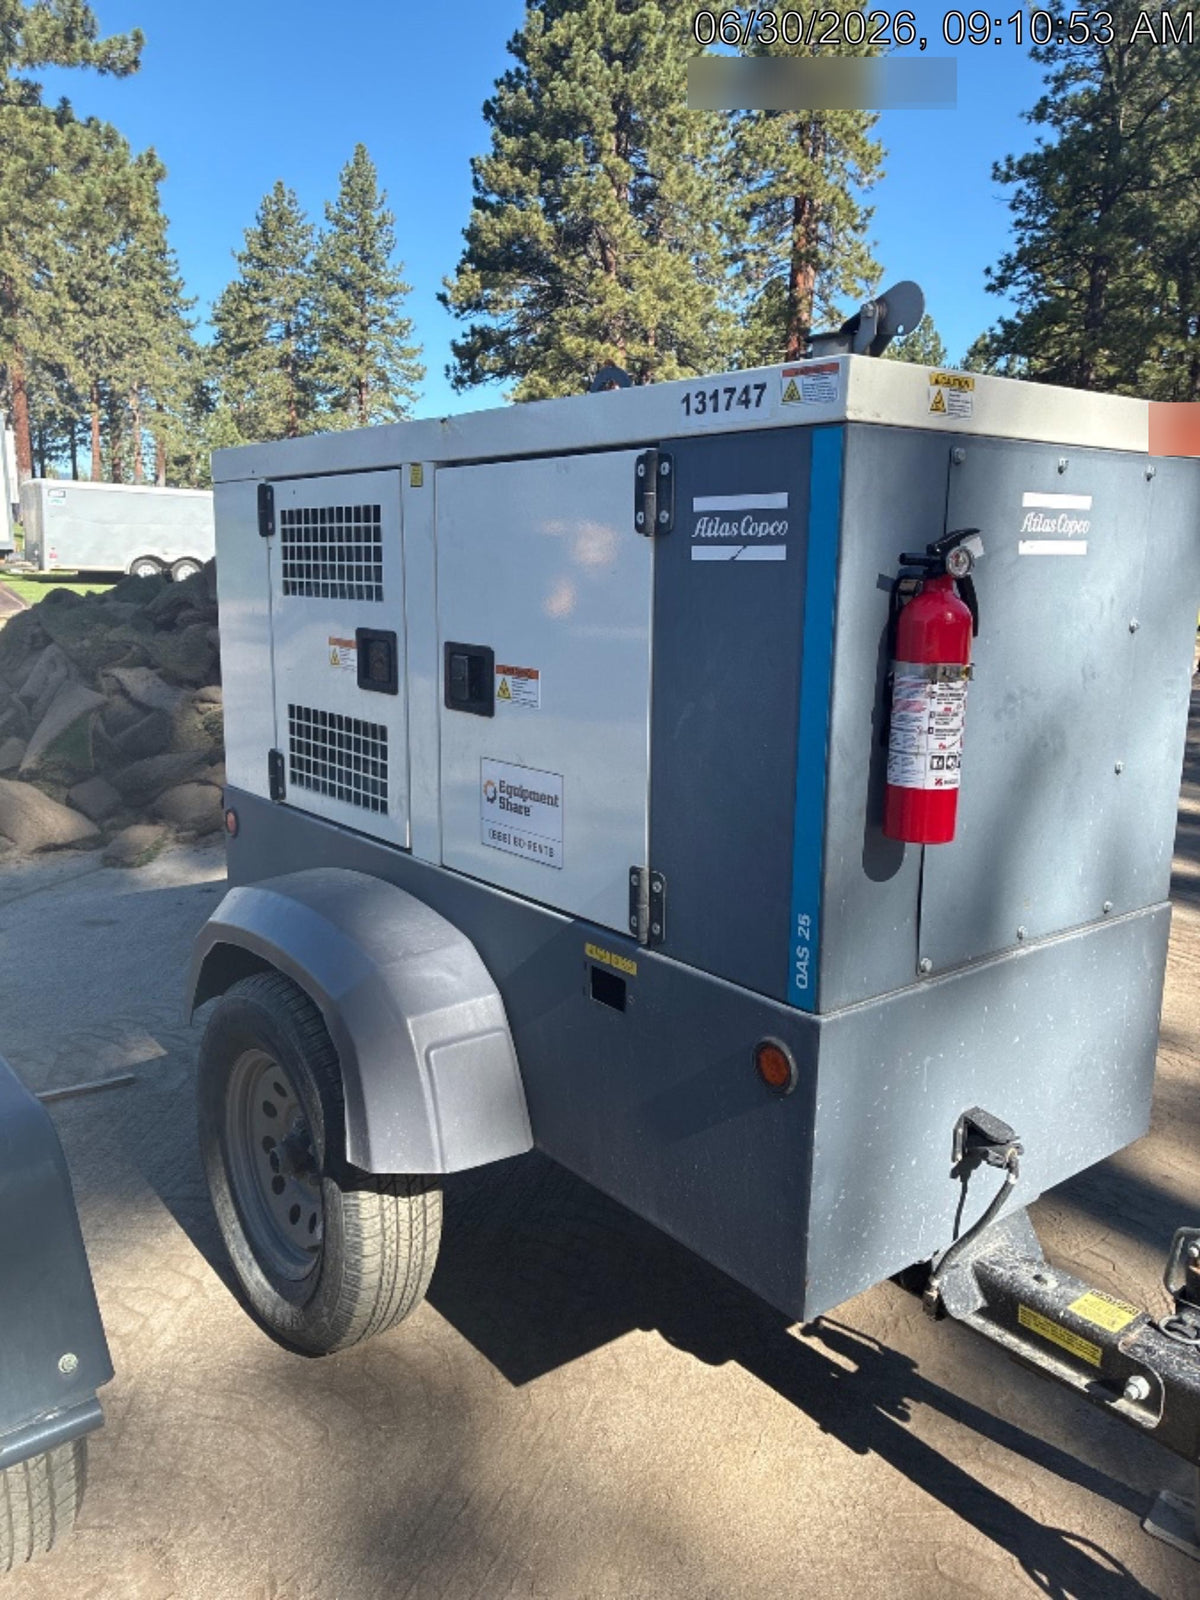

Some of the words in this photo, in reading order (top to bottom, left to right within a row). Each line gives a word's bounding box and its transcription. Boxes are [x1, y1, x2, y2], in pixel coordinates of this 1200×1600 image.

[681, 382, 768, 416] 131747
[691, 516, 739, 538] Atlas
[740, 514, 789, 538] Copco
[1020, 511, 1057, 533] Atlas
[1058, 512, 1091, 538] Copco
[499, 779, 560, 808] Equipment
[499, 795, 532, 817] Share
[797, 912, 811, 941] 25
